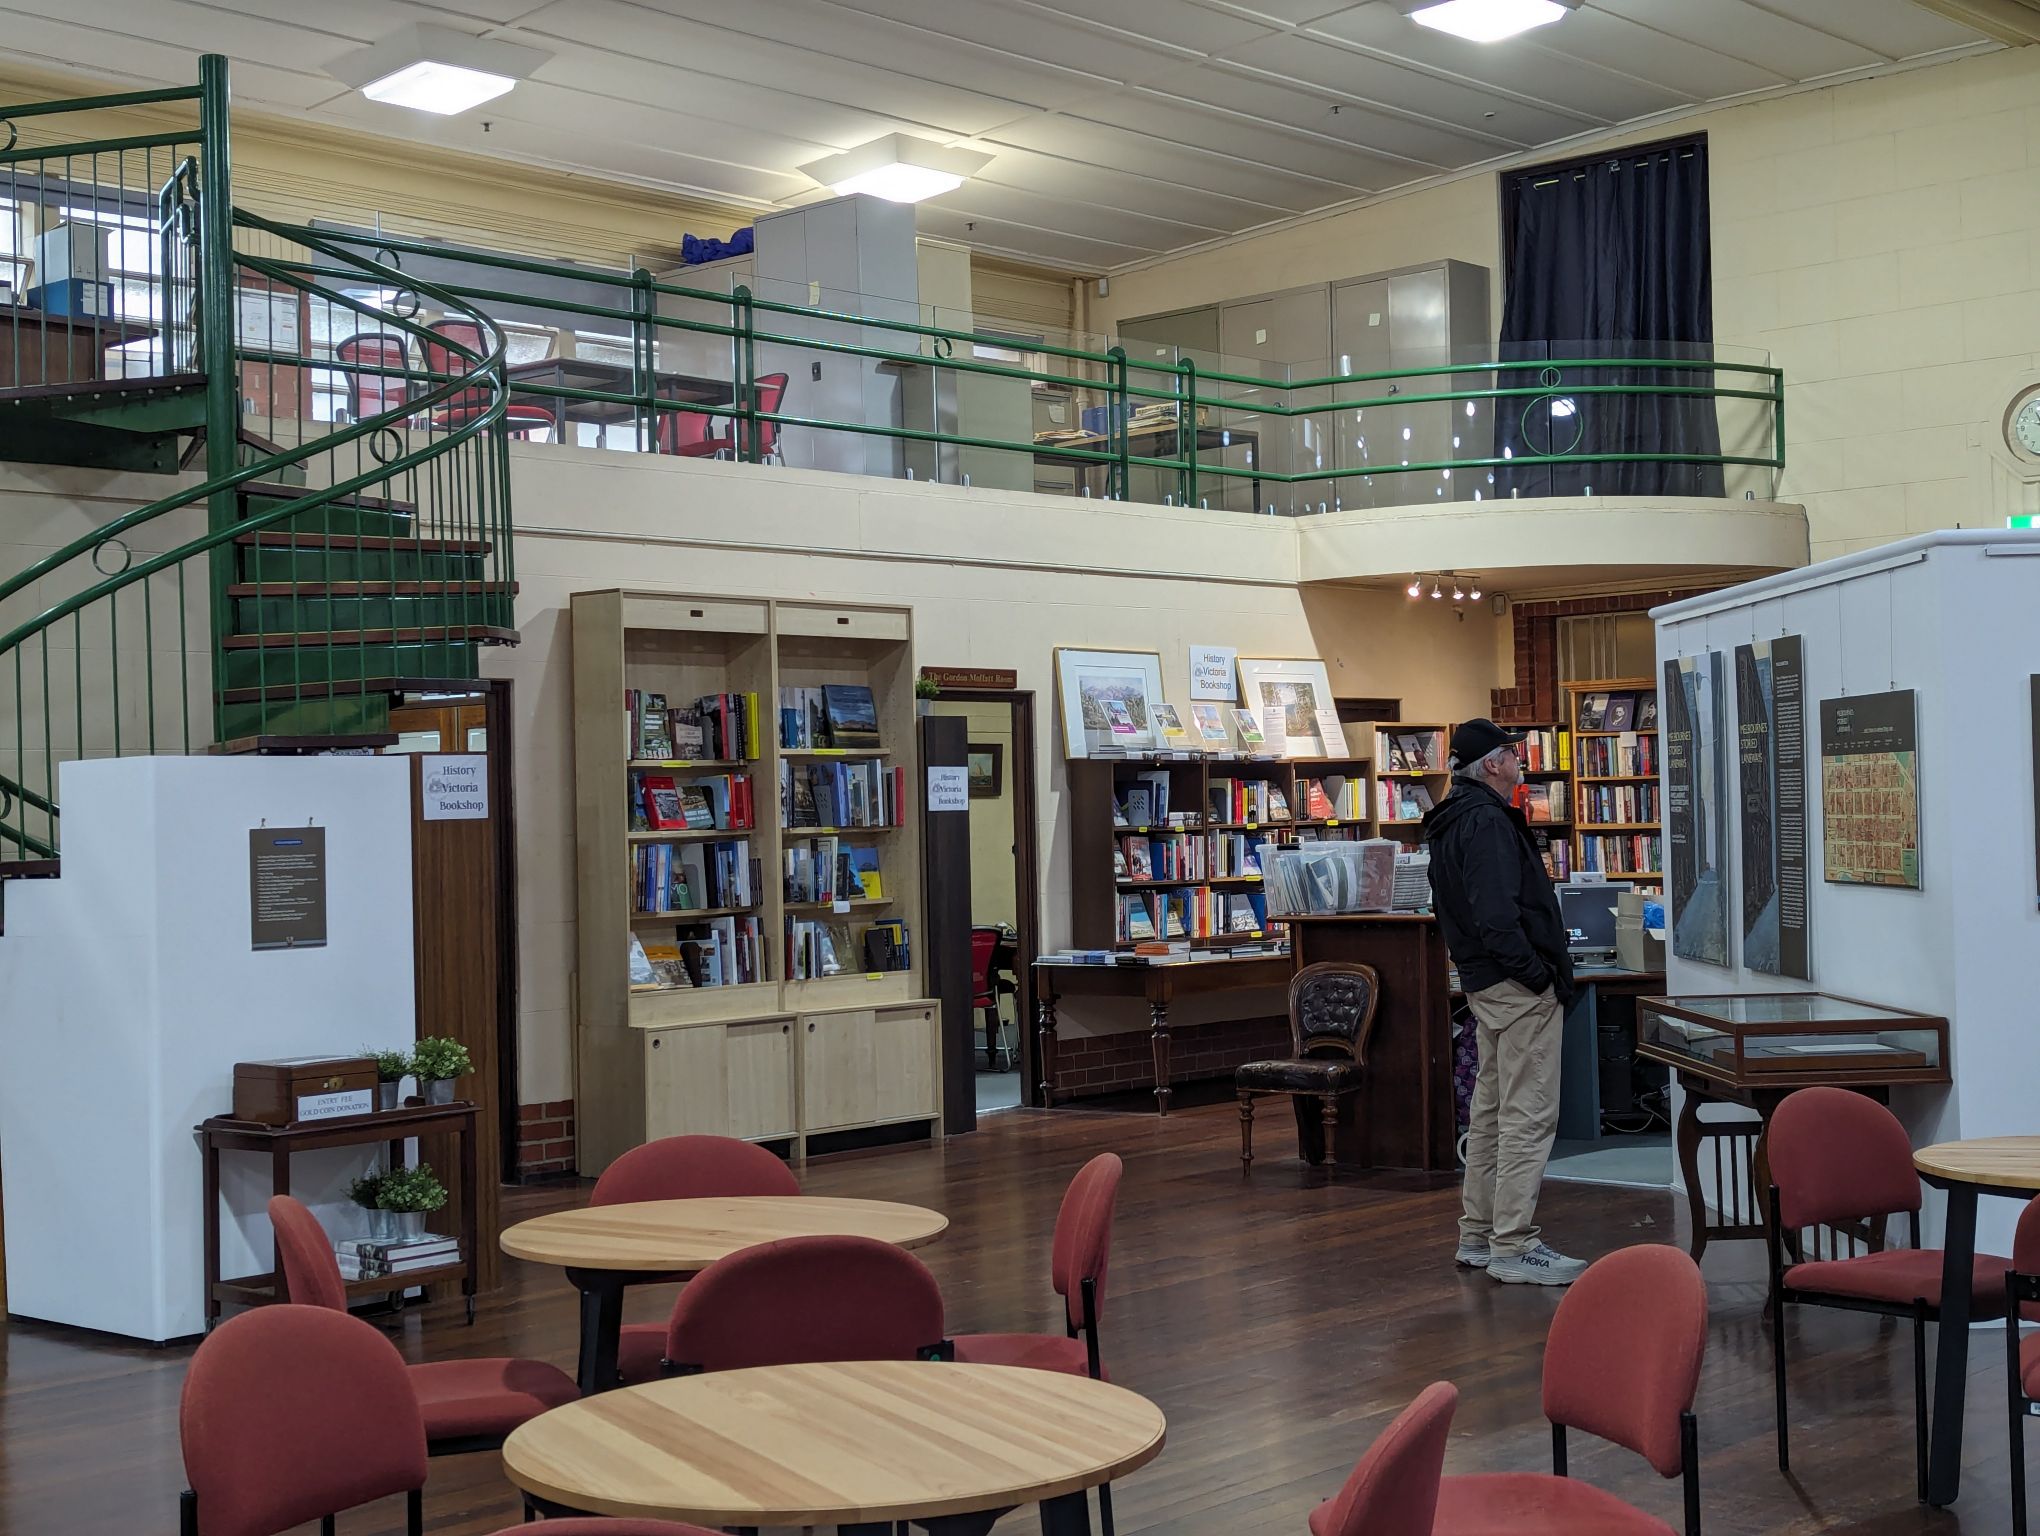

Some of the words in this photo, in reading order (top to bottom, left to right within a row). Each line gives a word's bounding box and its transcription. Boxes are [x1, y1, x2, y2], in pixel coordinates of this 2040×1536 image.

[1203, 654, 1225, 665] History
[1202, 666, 1227, 677] Victoria
[943, 673, 968, 682] Gordon
[995, 674, 1014, 683] Room
[1200, 680, 1231, 691] Bookshop
[442, 766, 476, 776] History
[441, 782, 478, 793] Victoria
[939, 785, 962, 793] Victoria
[440, 800, 484, 811] Bookshop
[938, 797, 966, 806] Bookshop
[318, 1097, 337, 1106] ENTRY
[341, 1095, 353, 1103] FEE
[319, 1106, 336, 1115] COIN
[337, 1103, 369, 1112] DONATION
[1521, 1255, 1549, 1268] HOKA
